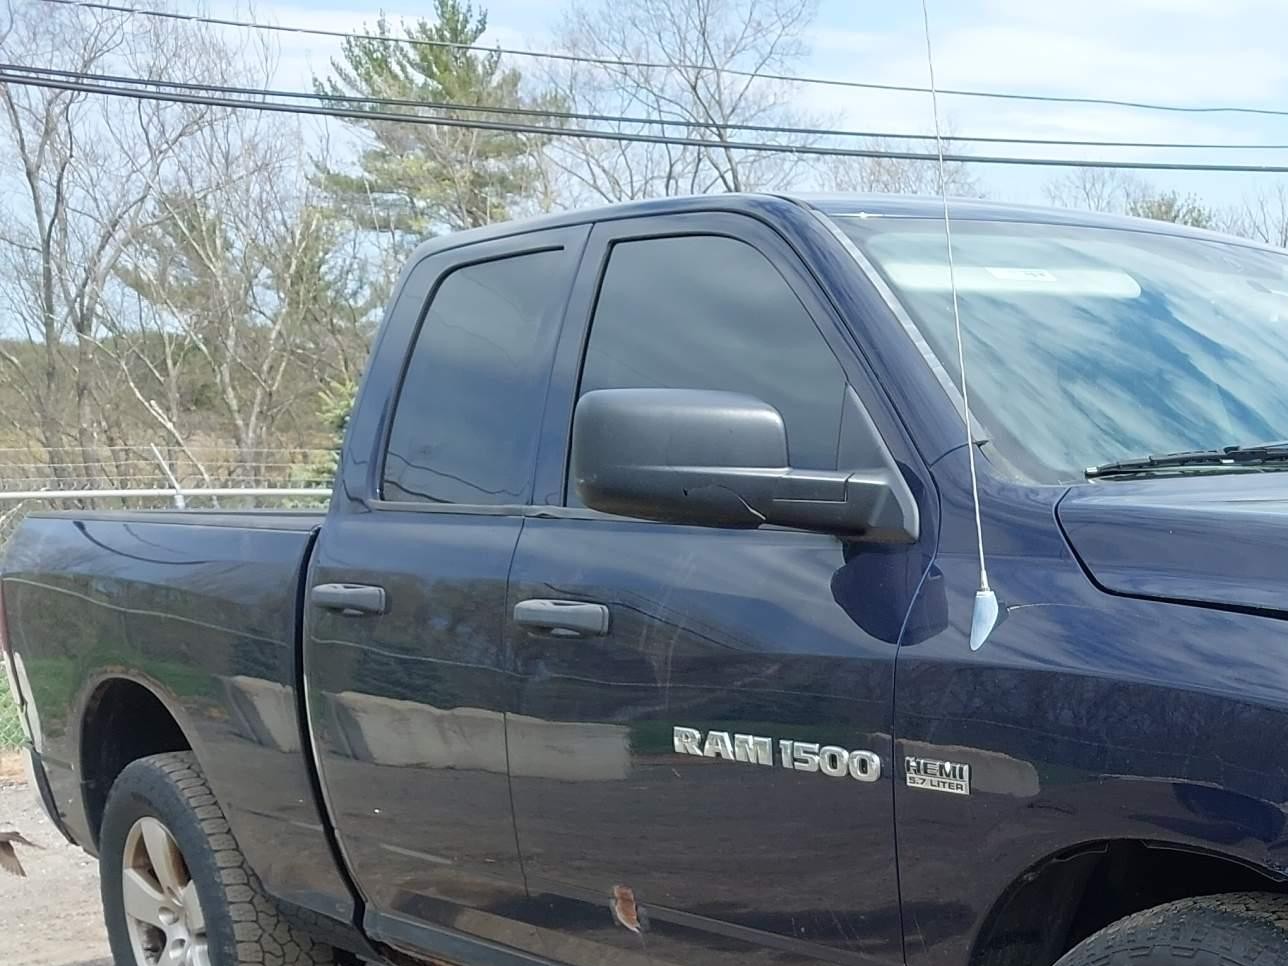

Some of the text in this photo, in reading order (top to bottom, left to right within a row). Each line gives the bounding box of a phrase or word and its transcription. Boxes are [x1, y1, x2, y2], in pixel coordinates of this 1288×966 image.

[673, 726, 881, 782] RAM 1500
[905, 757, 969, 782] HEMI
[908, 776, 964, 792] 5.7 LITER
